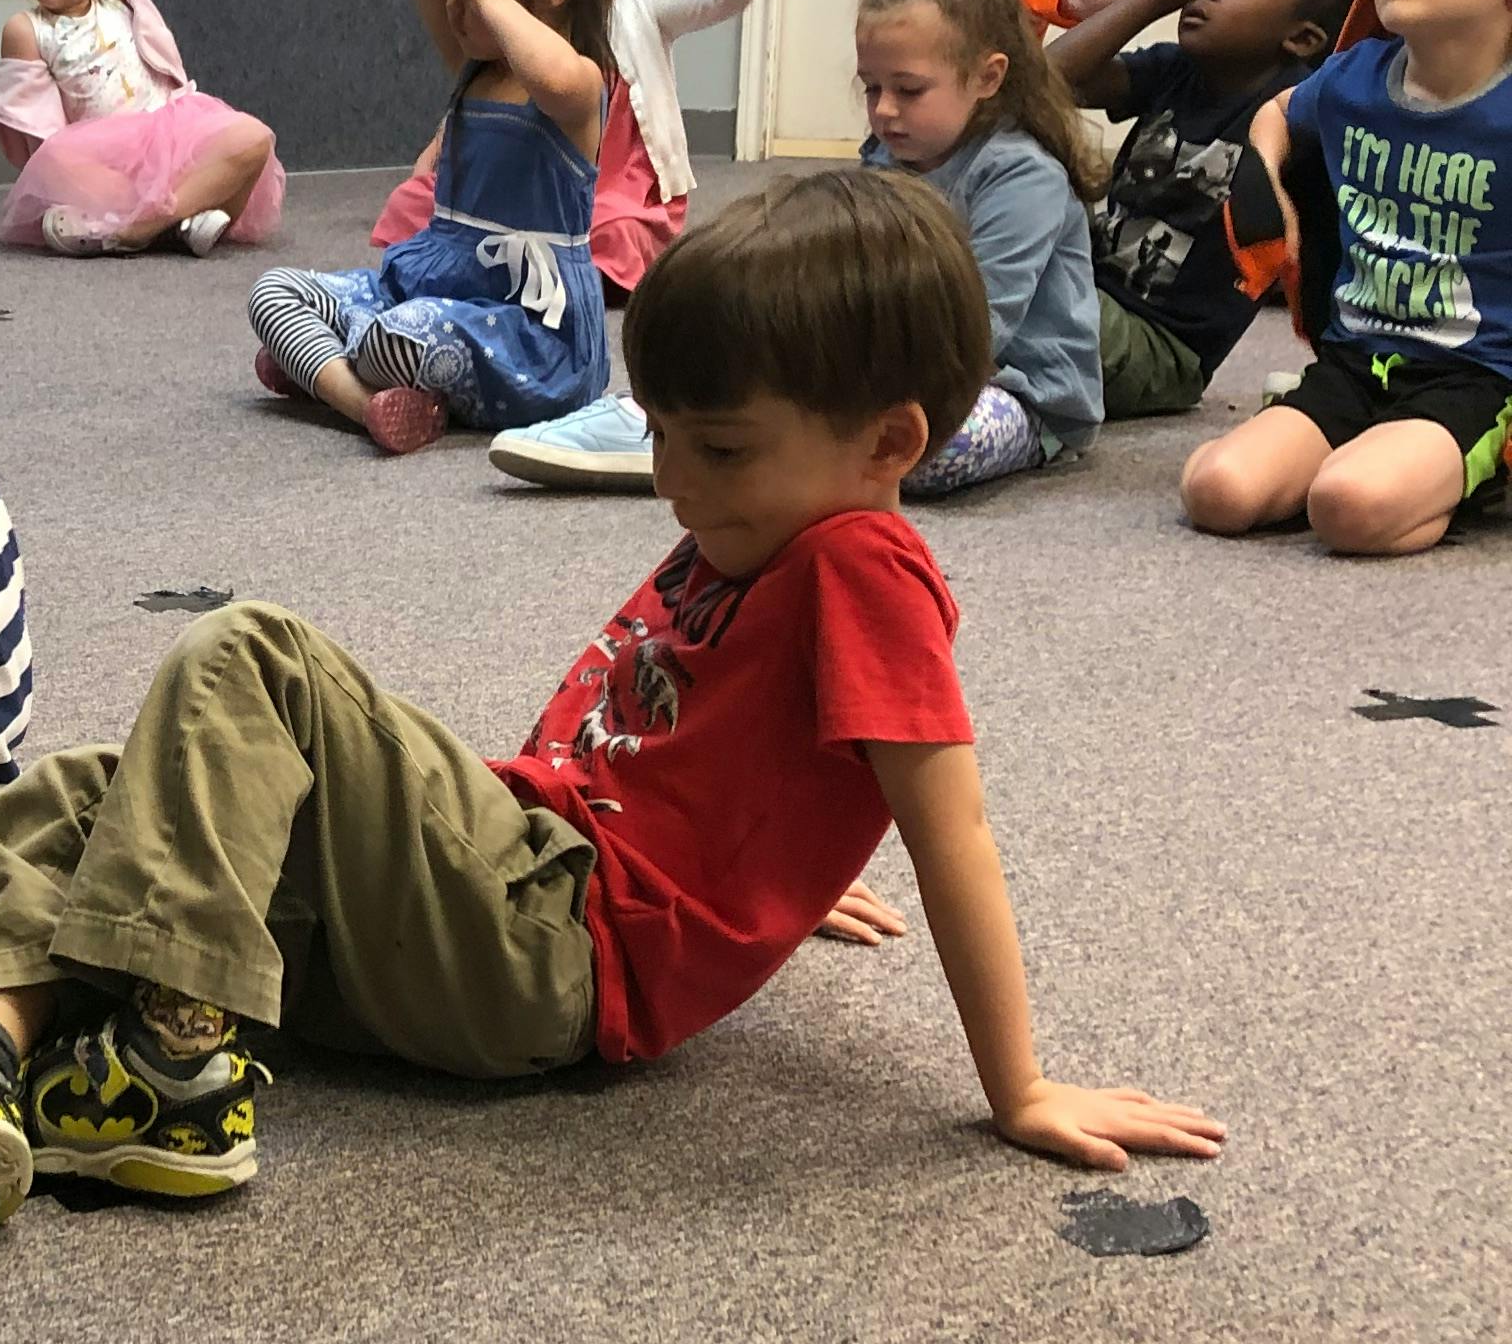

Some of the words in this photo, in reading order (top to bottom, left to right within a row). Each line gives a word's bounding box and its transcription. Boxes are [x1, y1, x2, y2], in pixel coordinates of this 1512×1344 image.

[1343, 125, 1390, 192] I'M
[1398, 142, 1497, 210] HERE
[1337, 184, 1399, 237] FOR
[1409, 206, 1482, 256] THE
[1343, 243, 1464, 320] SNACKS
